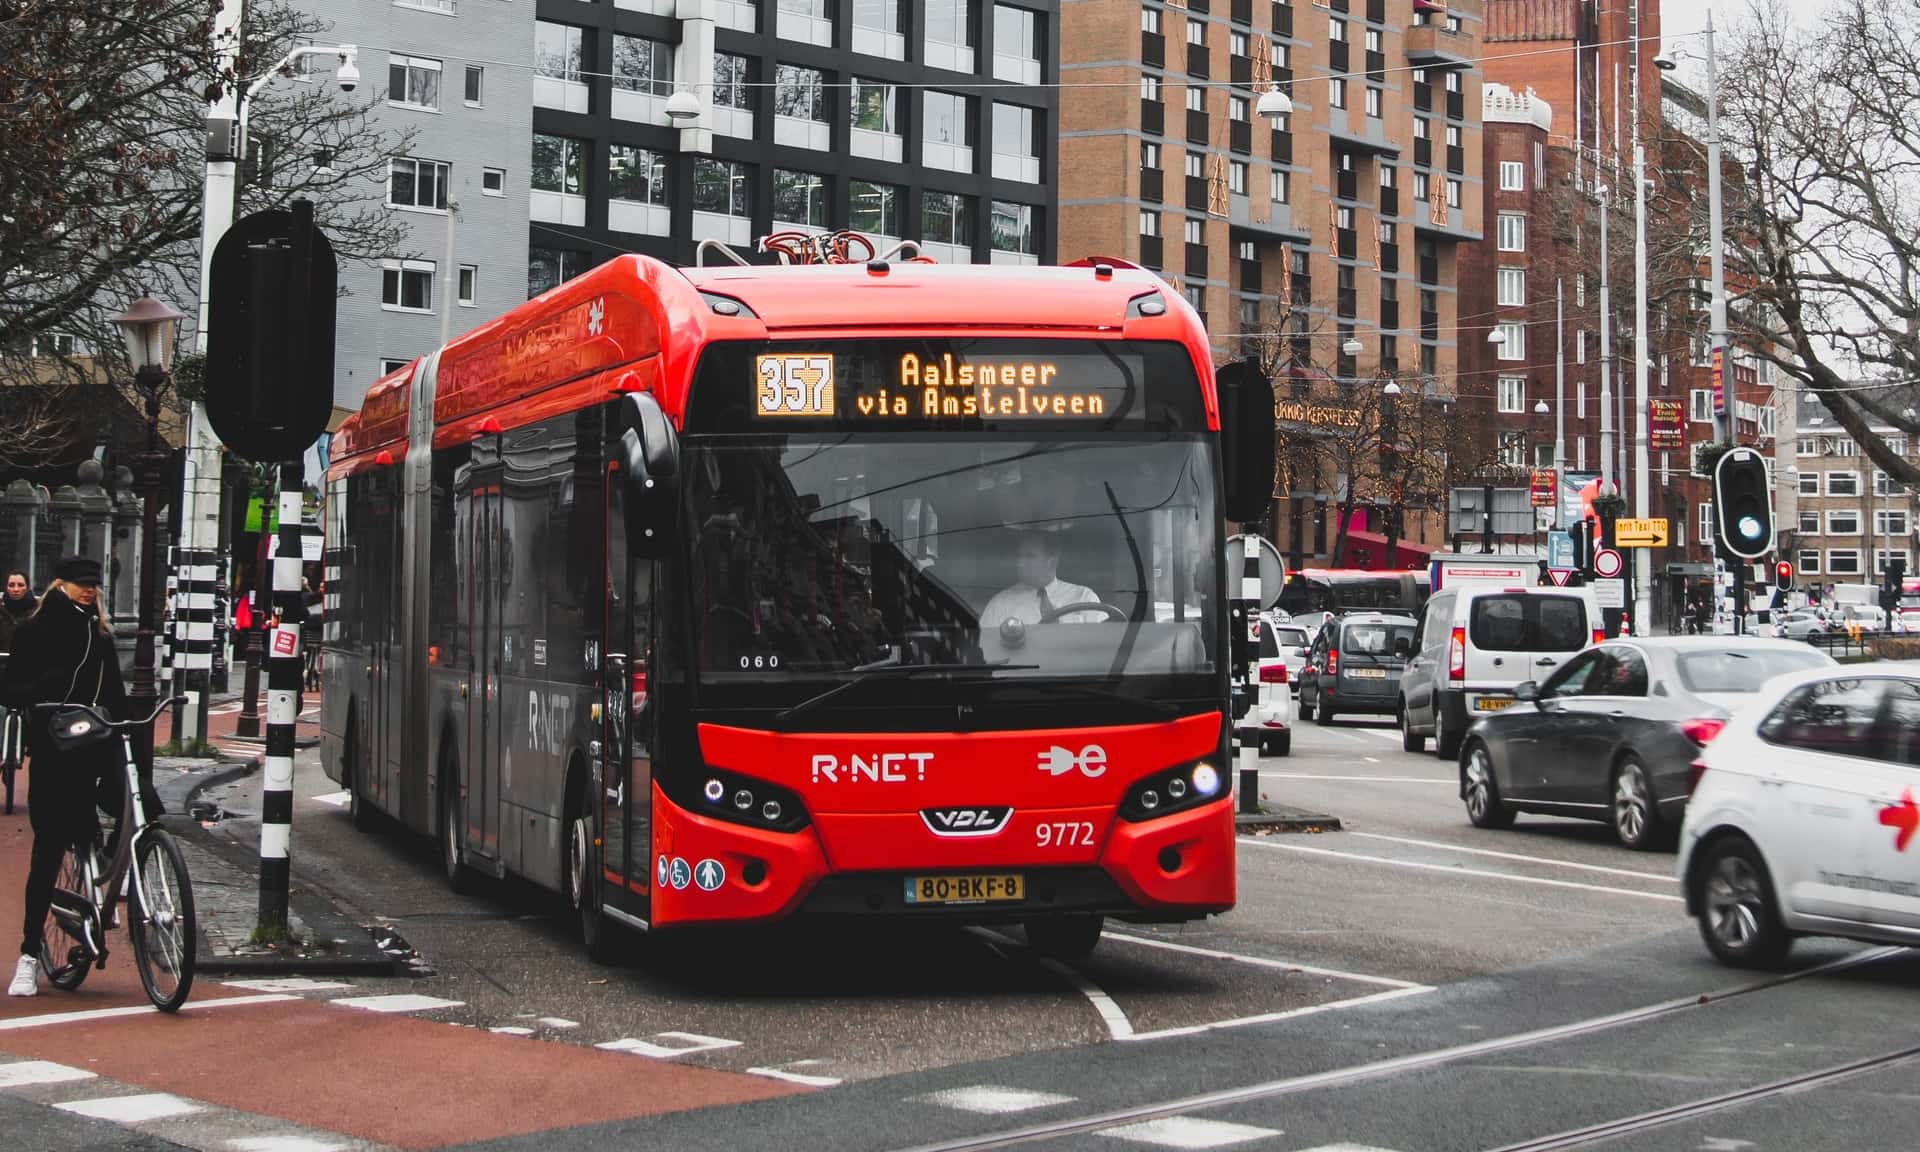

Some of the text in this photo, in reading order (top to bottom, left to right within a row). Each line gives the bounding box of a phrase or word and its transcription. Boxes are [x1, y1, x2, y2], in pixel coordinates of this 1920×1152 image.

[901, 353, 1056, 385] Aalsmeer
[758, 357, 832, 412] 357
[857, 387, 1104, 415] via Amstelveen
[1650, 400, 1682, 409] VIENNA
[1634, 521, 1651, 532] Taxi
[935, 809, 996, 828] VDL
[1035, 821, 1095, 847] 9772
[921, 877, 1018, 899] 80-BKF-8
